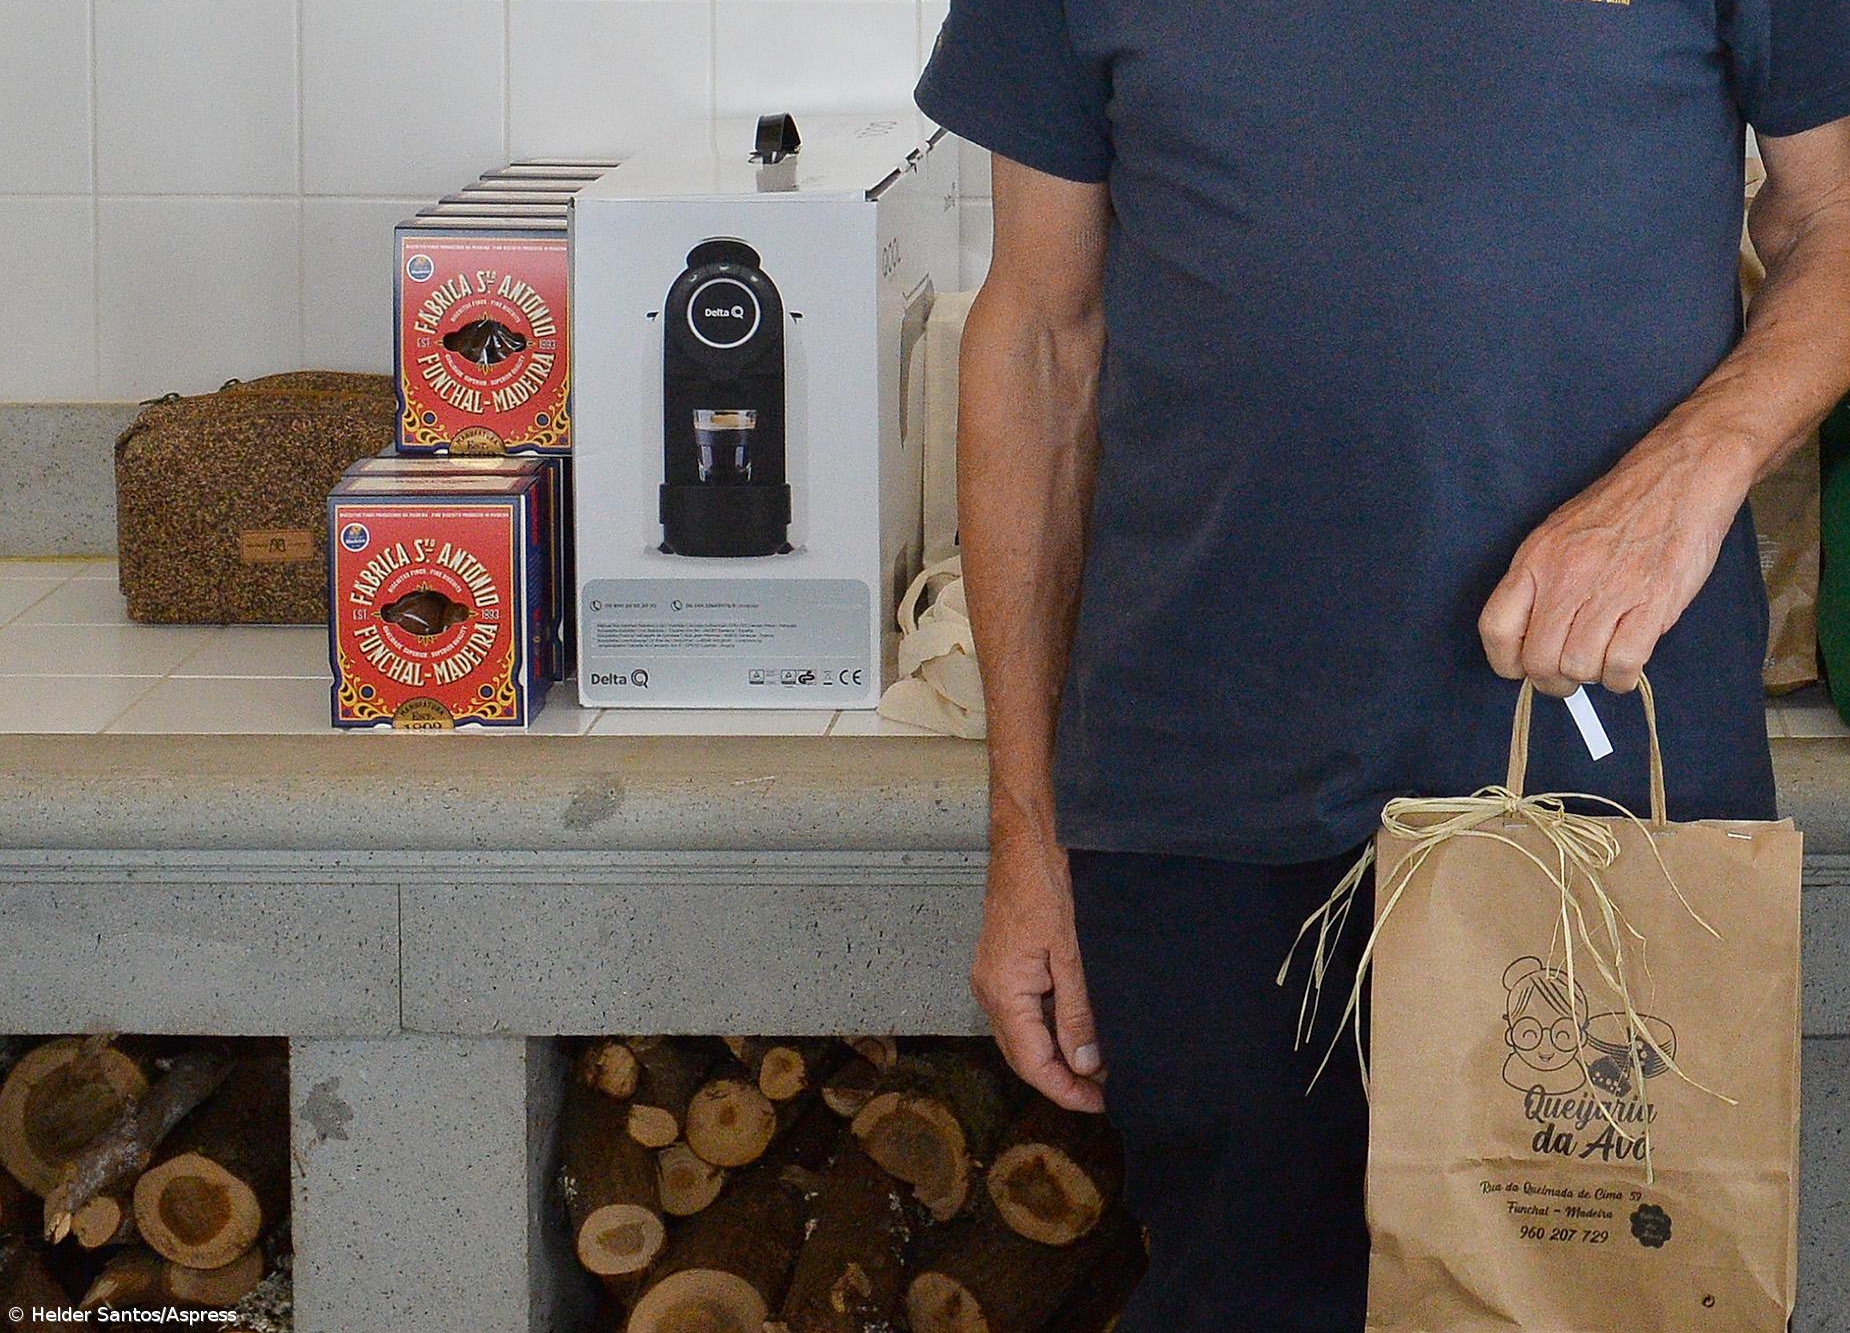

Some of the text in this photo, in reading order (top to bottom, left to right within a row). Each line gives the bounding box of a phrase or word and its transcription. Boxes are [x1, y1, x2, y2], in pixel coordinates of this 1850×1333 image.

[705, 305, 744, 319] Delta Q
[591, 669, 649, 688] Delta Q
[1524, 1084, 1657, 1131] Queijaria
[1532, 1122, 1578, 1157] da
[1480, 1181, 1502, 1195] Rua
[1523, 1181, 1573, 1199] Queimada
[1594, 1187, 1623, 1201] Cima
[1629, 1191, 1642, 1202] 59
[1506, 1200, 1550, 1216] Funchal
[1564, 1205, 1613, 1219] Madeira
[1519, 1225, 1609, 1244] 960 207 729
